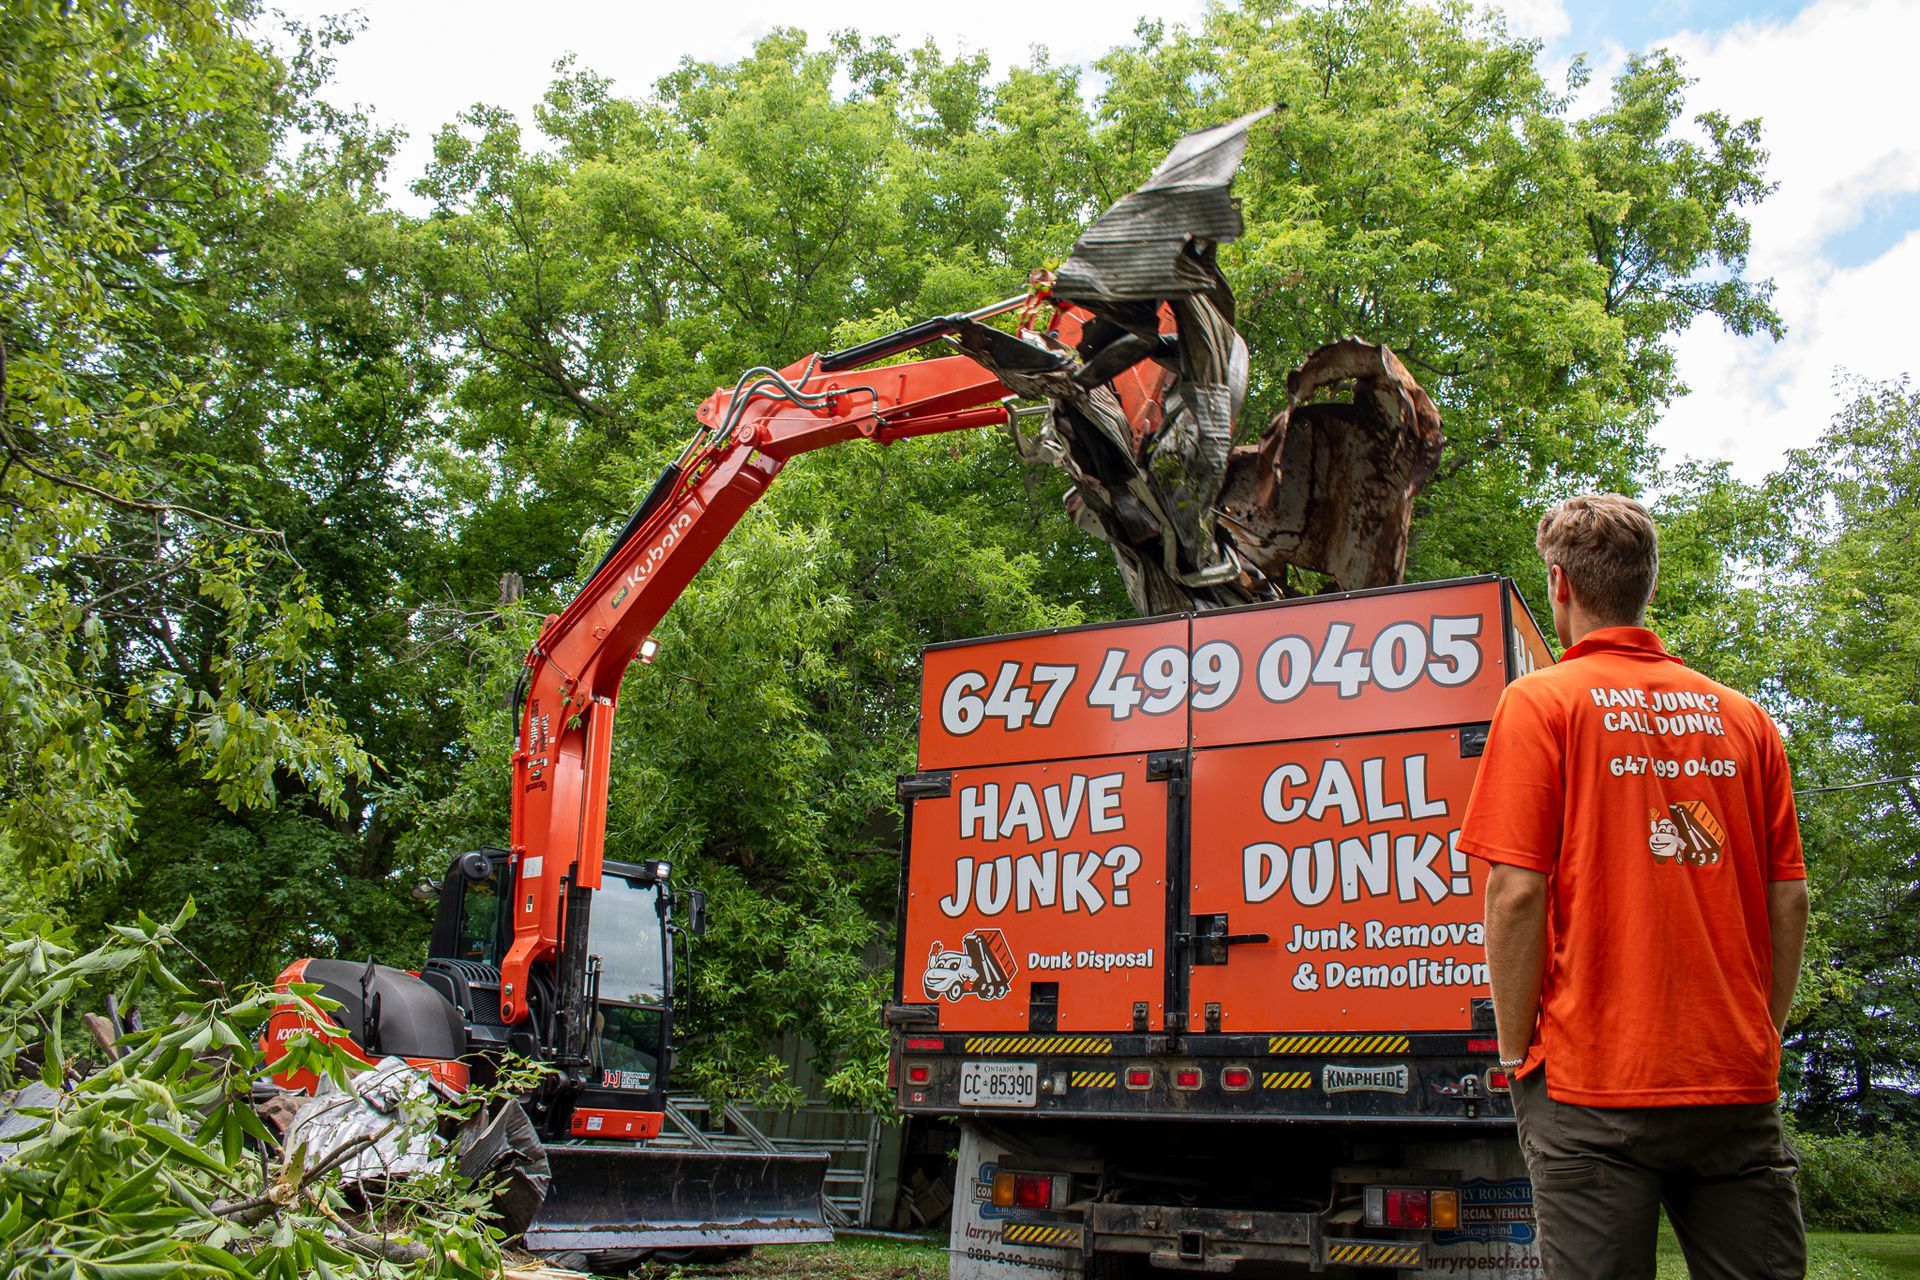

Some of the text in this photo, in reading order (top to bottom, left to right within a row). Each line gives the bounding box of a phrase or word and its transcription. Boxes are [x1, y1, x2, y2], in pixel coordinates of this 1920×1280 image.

[627, 513, 692, 588] Kubota
[941, 660, 1079, 737] 647
[1087, 640, 1243, 721] 499
[1257, 614, 1483, 703] 0405
[1590, 687, 1720, 713] HAVE JUNK?
[1603, 710, 1726, 737] CALL DUNK!
[1609, 755, 1648, 777] 647
[1684, 757, 1737, 777] 0405
[1262, 753, 1449, 827] CALL
[960, 772, 1125, 844] HAVE
[1242, 828, 1473, 906] DUNK!
[939, 845, 1142, 919] JUNK?
[1286, 920, 1485, 953] Junk Remova
[1028, 949, 1153, 973] Dunk Disposal
[1292, 957, 1490, 992] & Demolition
[964, 1074, 1033, 1095] CC 85390
[1327, 1069, 1404, 1089] KNAPHEIDE
[1480, 1187, 1531, 1200] ROESCH
[1463, 1208, 1492, 1220] RCIAL
[1426, 1246, 1541, 1274] arryroesch.co
